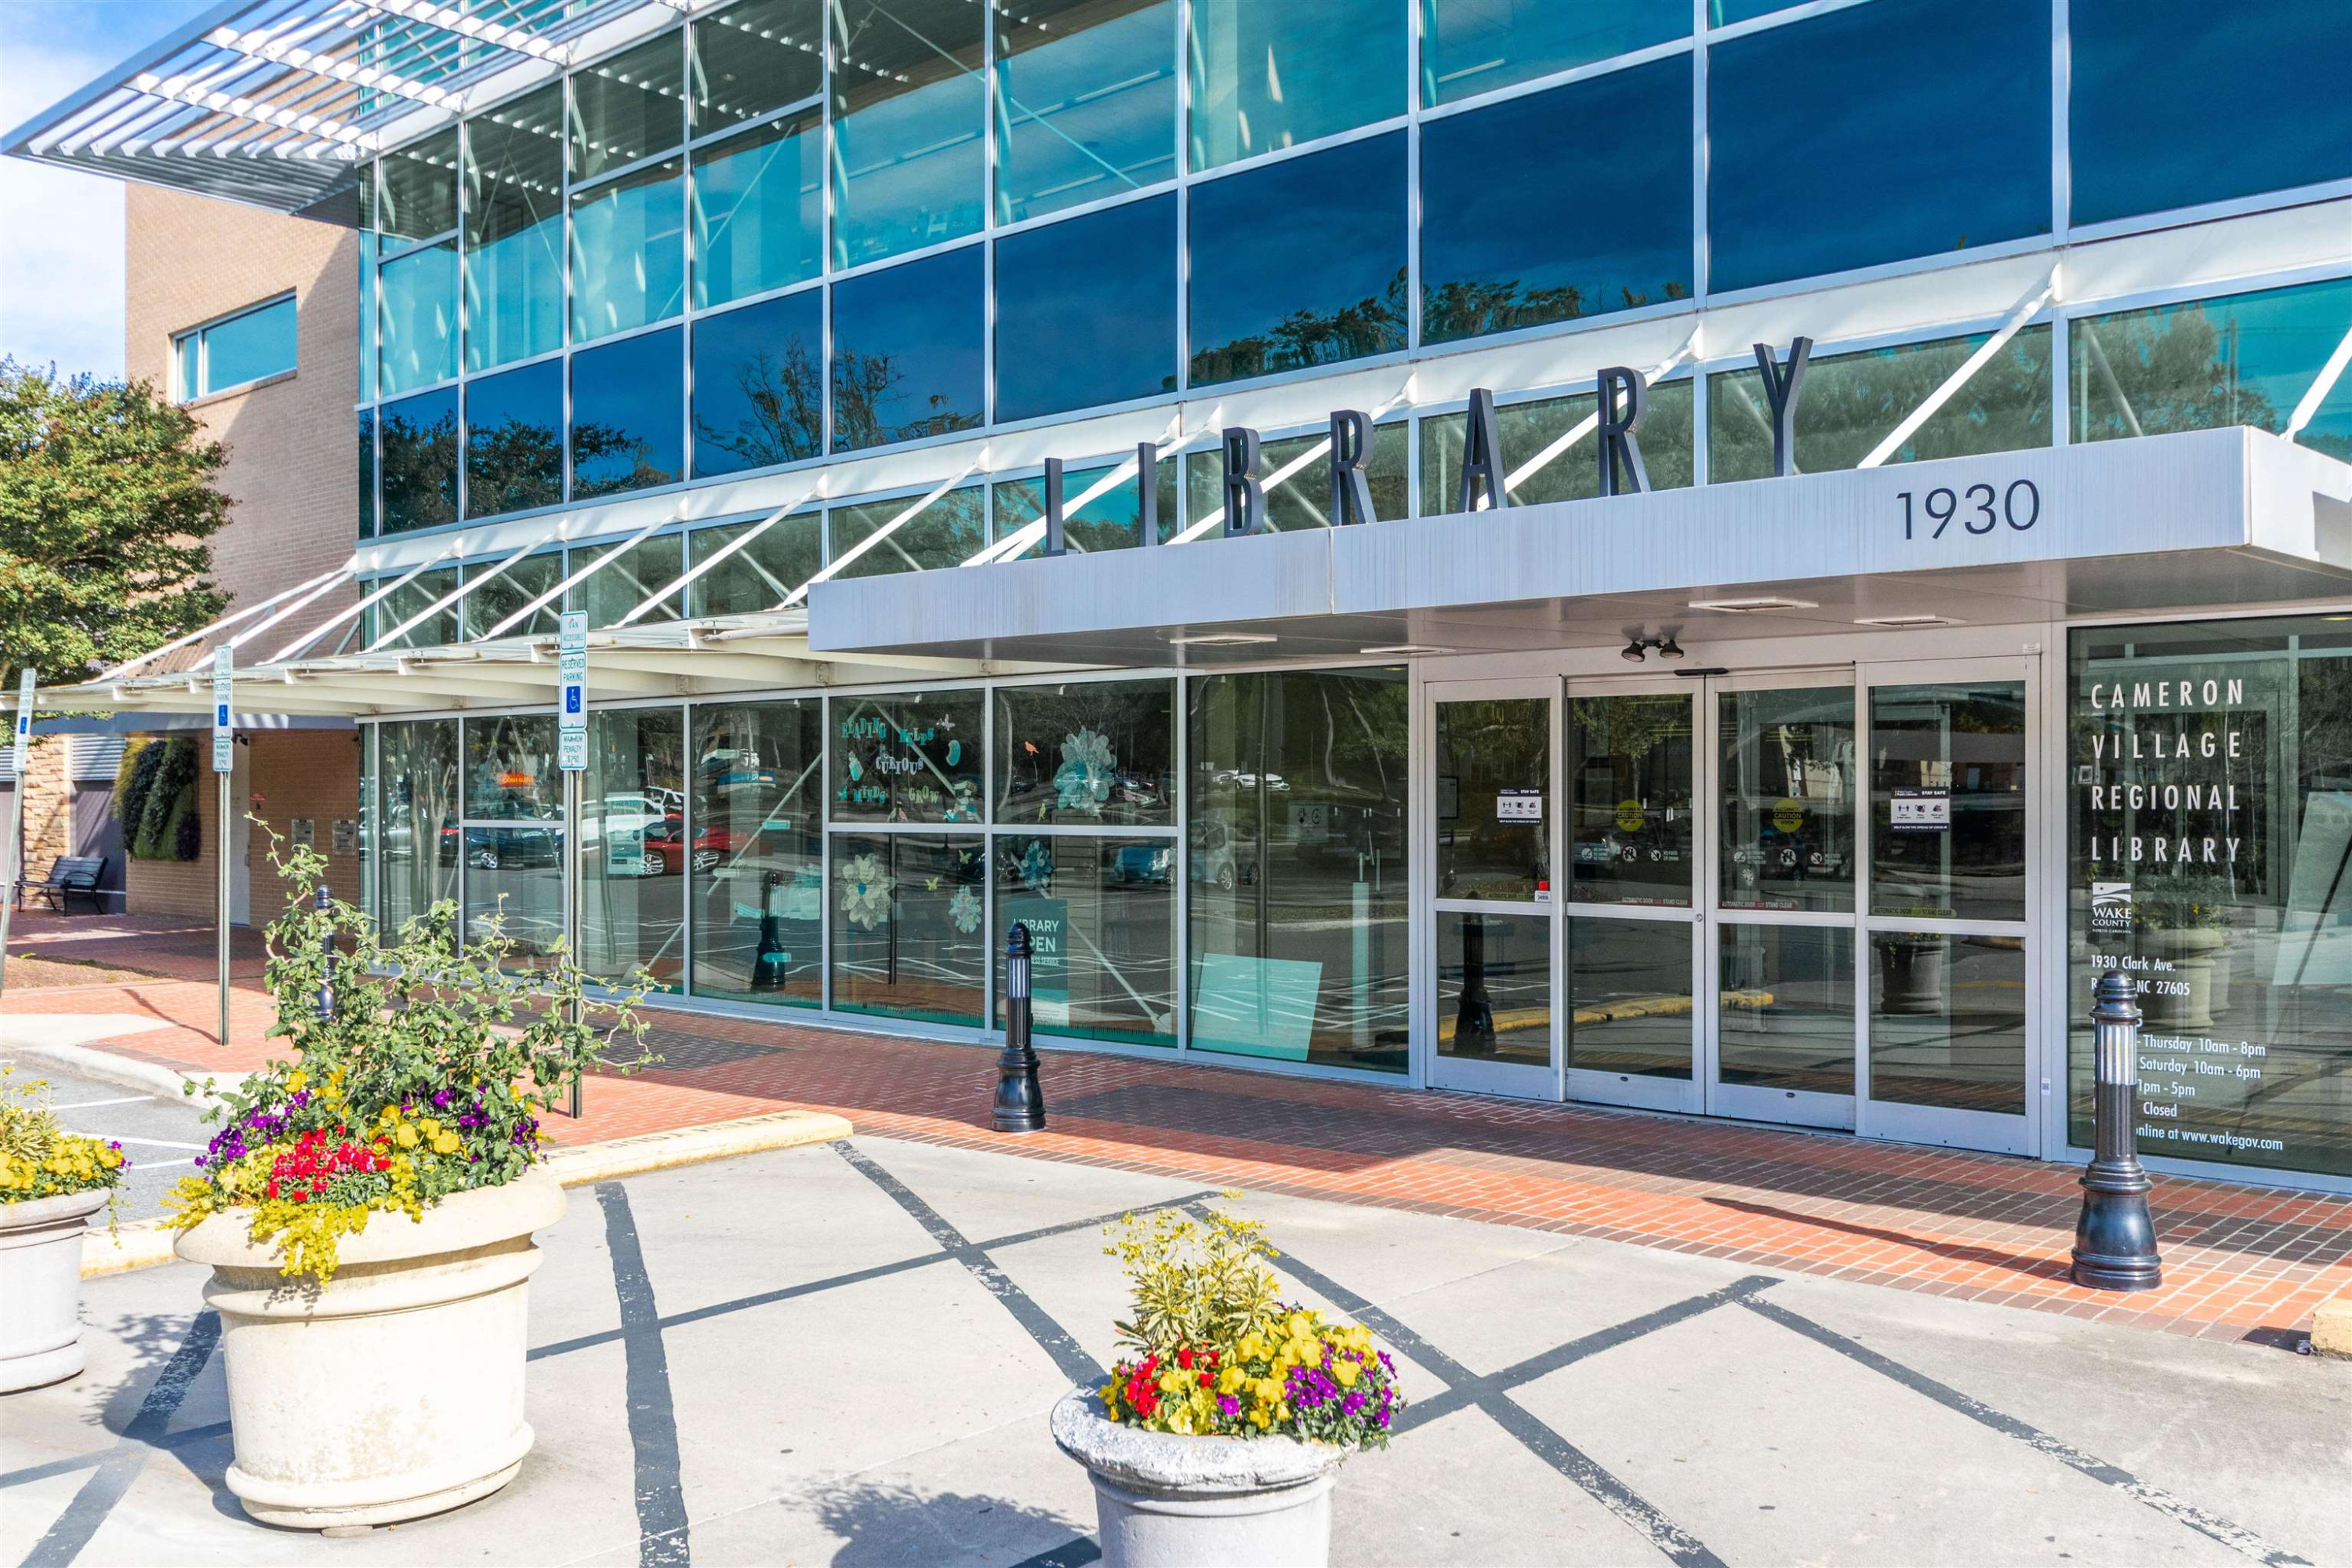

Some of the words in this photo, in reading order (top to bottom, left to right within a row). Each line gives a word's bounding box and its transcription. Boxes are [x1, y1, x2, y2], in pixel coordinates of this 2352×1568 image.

[1045, 336, 1813, 556] LIBRARY
[1896, 479, 2039, 540] 1930
[2091, 679, 2243, 708] CAMERON
[841, 717, 887, 740] READING
[2092, 732, 2241, 759] VILLAGE
[909, 786, 939, 804] GROW
[2091, 785, 2241, 810] REGIONAL
[2092, 837, 2241, 862] LIBRARY
[2092, 907, 2132, 919] WAKE
[1029, 936, 1056, 953] PEN
[2091, 955, 2117, 968] 1930
[2122, 956, 2149, 971] Clark
[2154, 958, 2176, 971] Ave.
[2136, 980, 2151, 993] NC
[2156, 981, 2190, 996] 27605
[2143, 1034, 2192, 1053] Thursday
[2198, 1038, 2229, 1054] 10am
[2241, 1041, 2266, 1058] 8pm
[2140, 1057, 2187, 1076] Saturday
[2194, 1060, 2224, 1076] 10am
[2236, 1066, 2261, 1080] 6pm
[2137, 1078, 2161, 1095] 1pm
[2171, 1082, 2196, 1098] 5pm
[2143, 1101, 2177, 1117] Closed
[2168, 1127, 2179, 1140] at
[2181, 1131, 2284, 1151] www.wakegov.com
